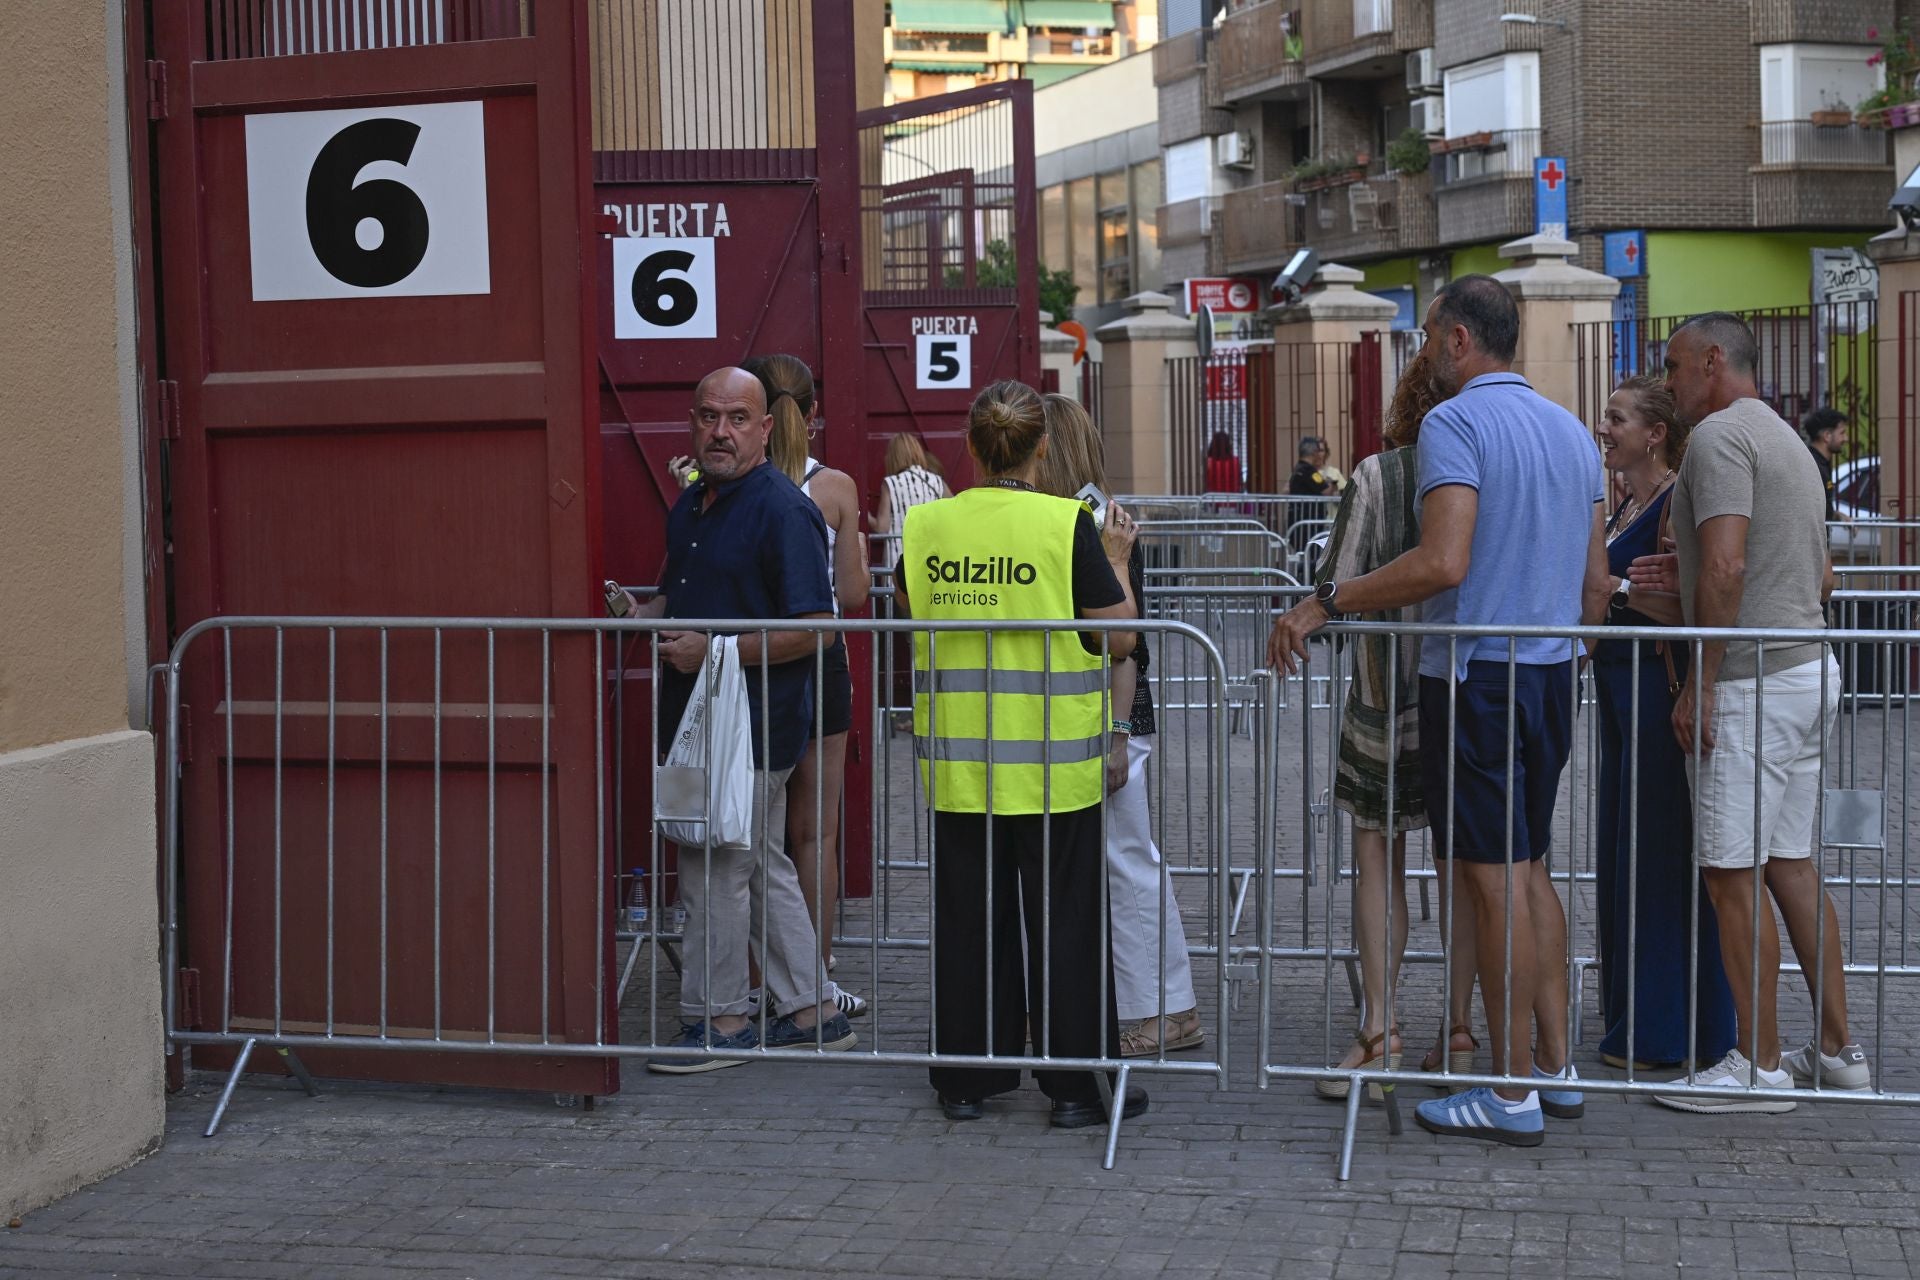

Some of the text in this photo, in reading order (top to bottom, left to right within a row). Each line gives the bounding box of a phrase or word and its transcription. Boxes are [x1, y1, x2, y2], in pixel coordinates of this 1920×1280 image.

[306, 117, 430, 288] 6
[603, 202, 731, 239] PUERTA
[631, 249, 698, 327] 6
[911, 316, 978, 335] PUERTA
[928, 341, 960, 382] 5
[926, 556, 1037, 586] Salzillo
